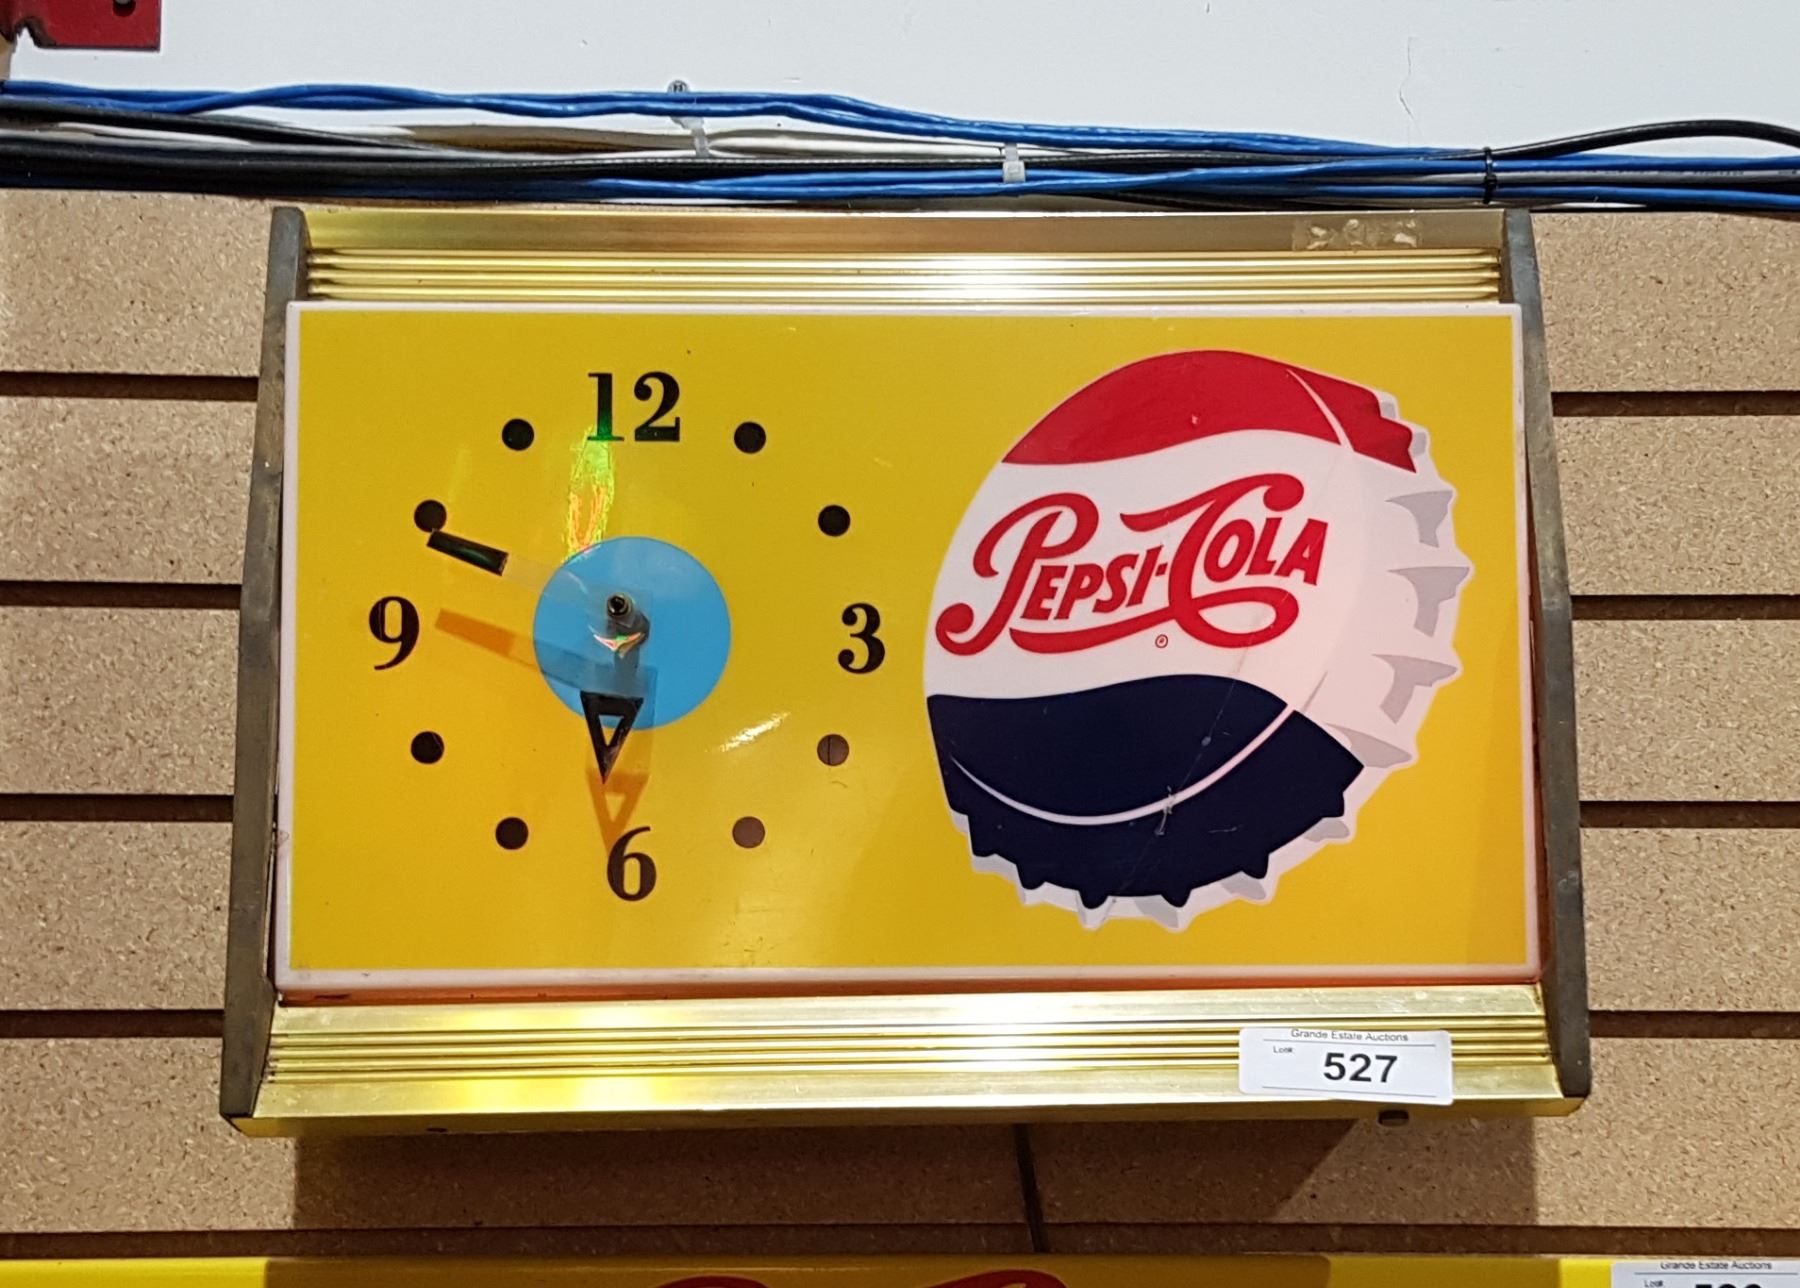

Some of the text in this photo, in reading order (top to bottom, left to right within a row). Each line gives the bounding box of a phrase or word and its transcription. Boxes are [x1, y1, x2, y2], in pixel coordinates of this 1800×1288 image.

[587, 371, 681, 442] 12
[368, 596, 420, 671] 9
[837, 602, 886, 674] 3
[606, 826, 657, 902] 6
[1290, 1028, 1409, 1042] Grande Estate Auctions
[1323, 1051, 1399, 1084] 527
